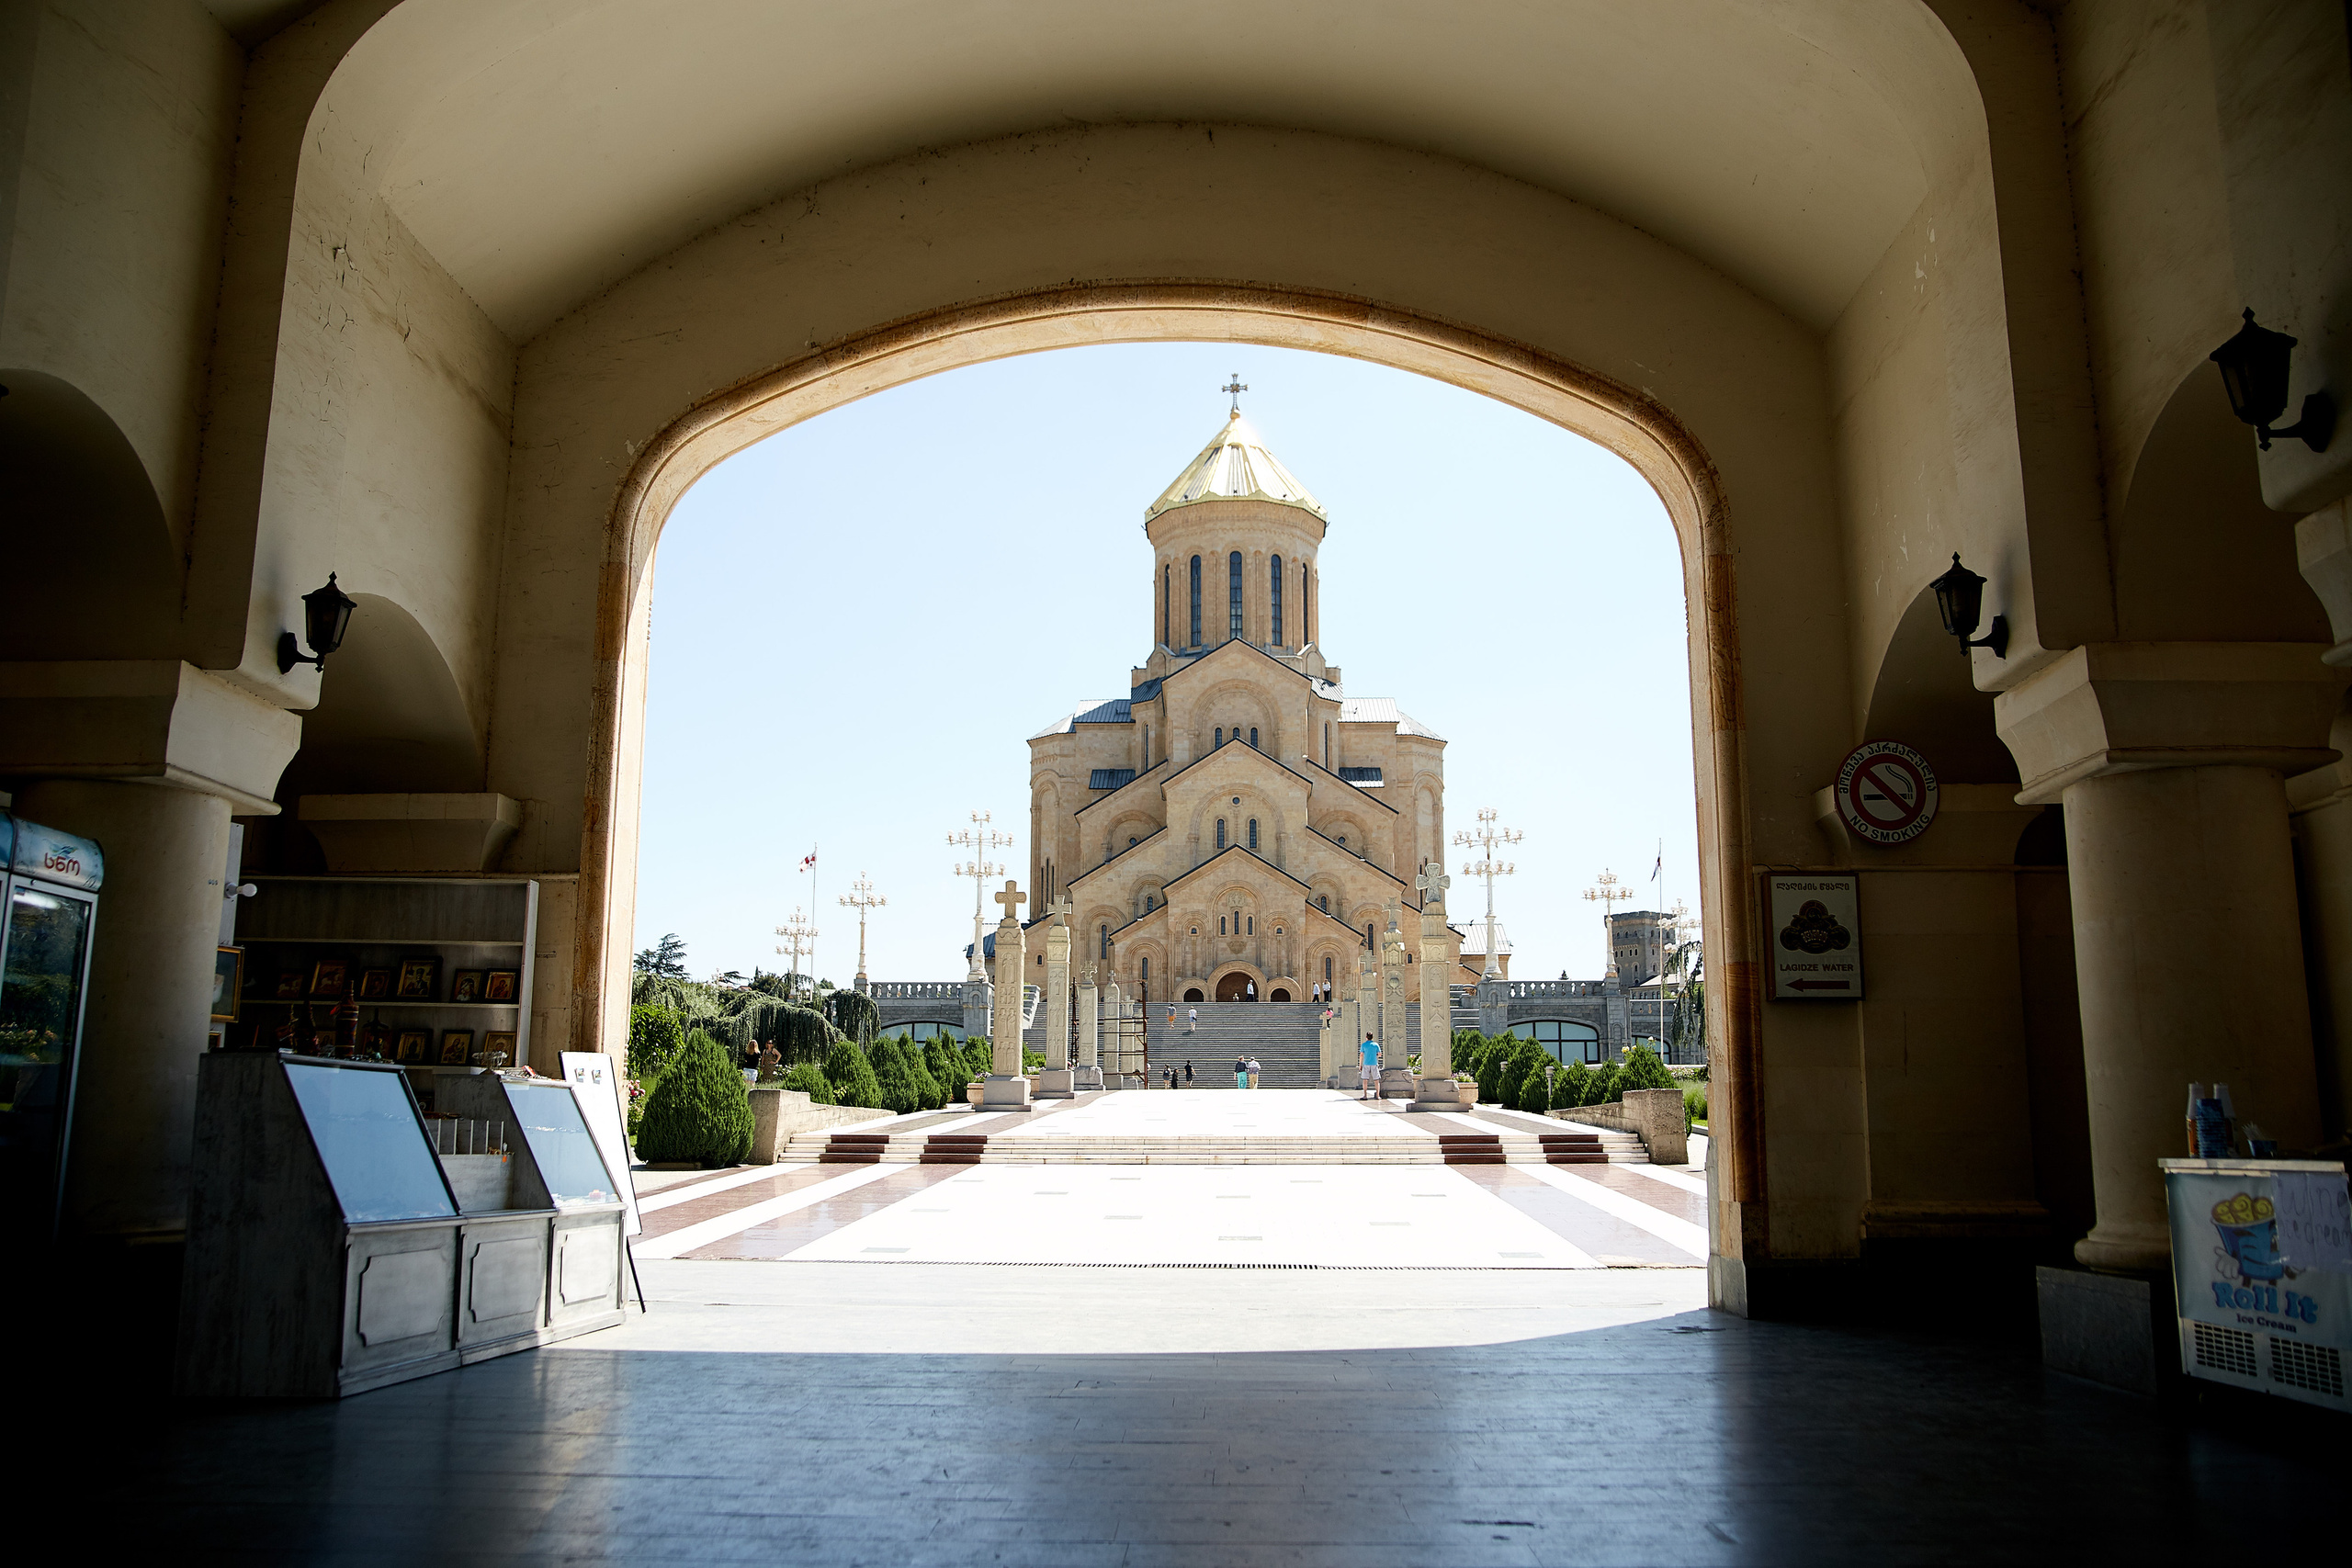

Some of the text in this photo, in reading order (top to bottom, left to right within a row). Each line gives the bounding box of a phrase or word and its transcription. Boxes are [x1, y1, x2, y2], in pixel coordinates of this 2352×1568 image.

[1838, 742, 1937, 795] მოწევა აკრძალულია
[1849, 814, 1930, 842] NO SMOKING
[44, 852, 81, 876] სნო
[1776, 882, 1850, 891] ლაღიძის წყალი
[1780, 964, 1854, 972] LAGIDZE WATER
[2211, 1281, 2319, 1325] Roll It
[2236, 1313, 2298, 1334] Ice Cream
